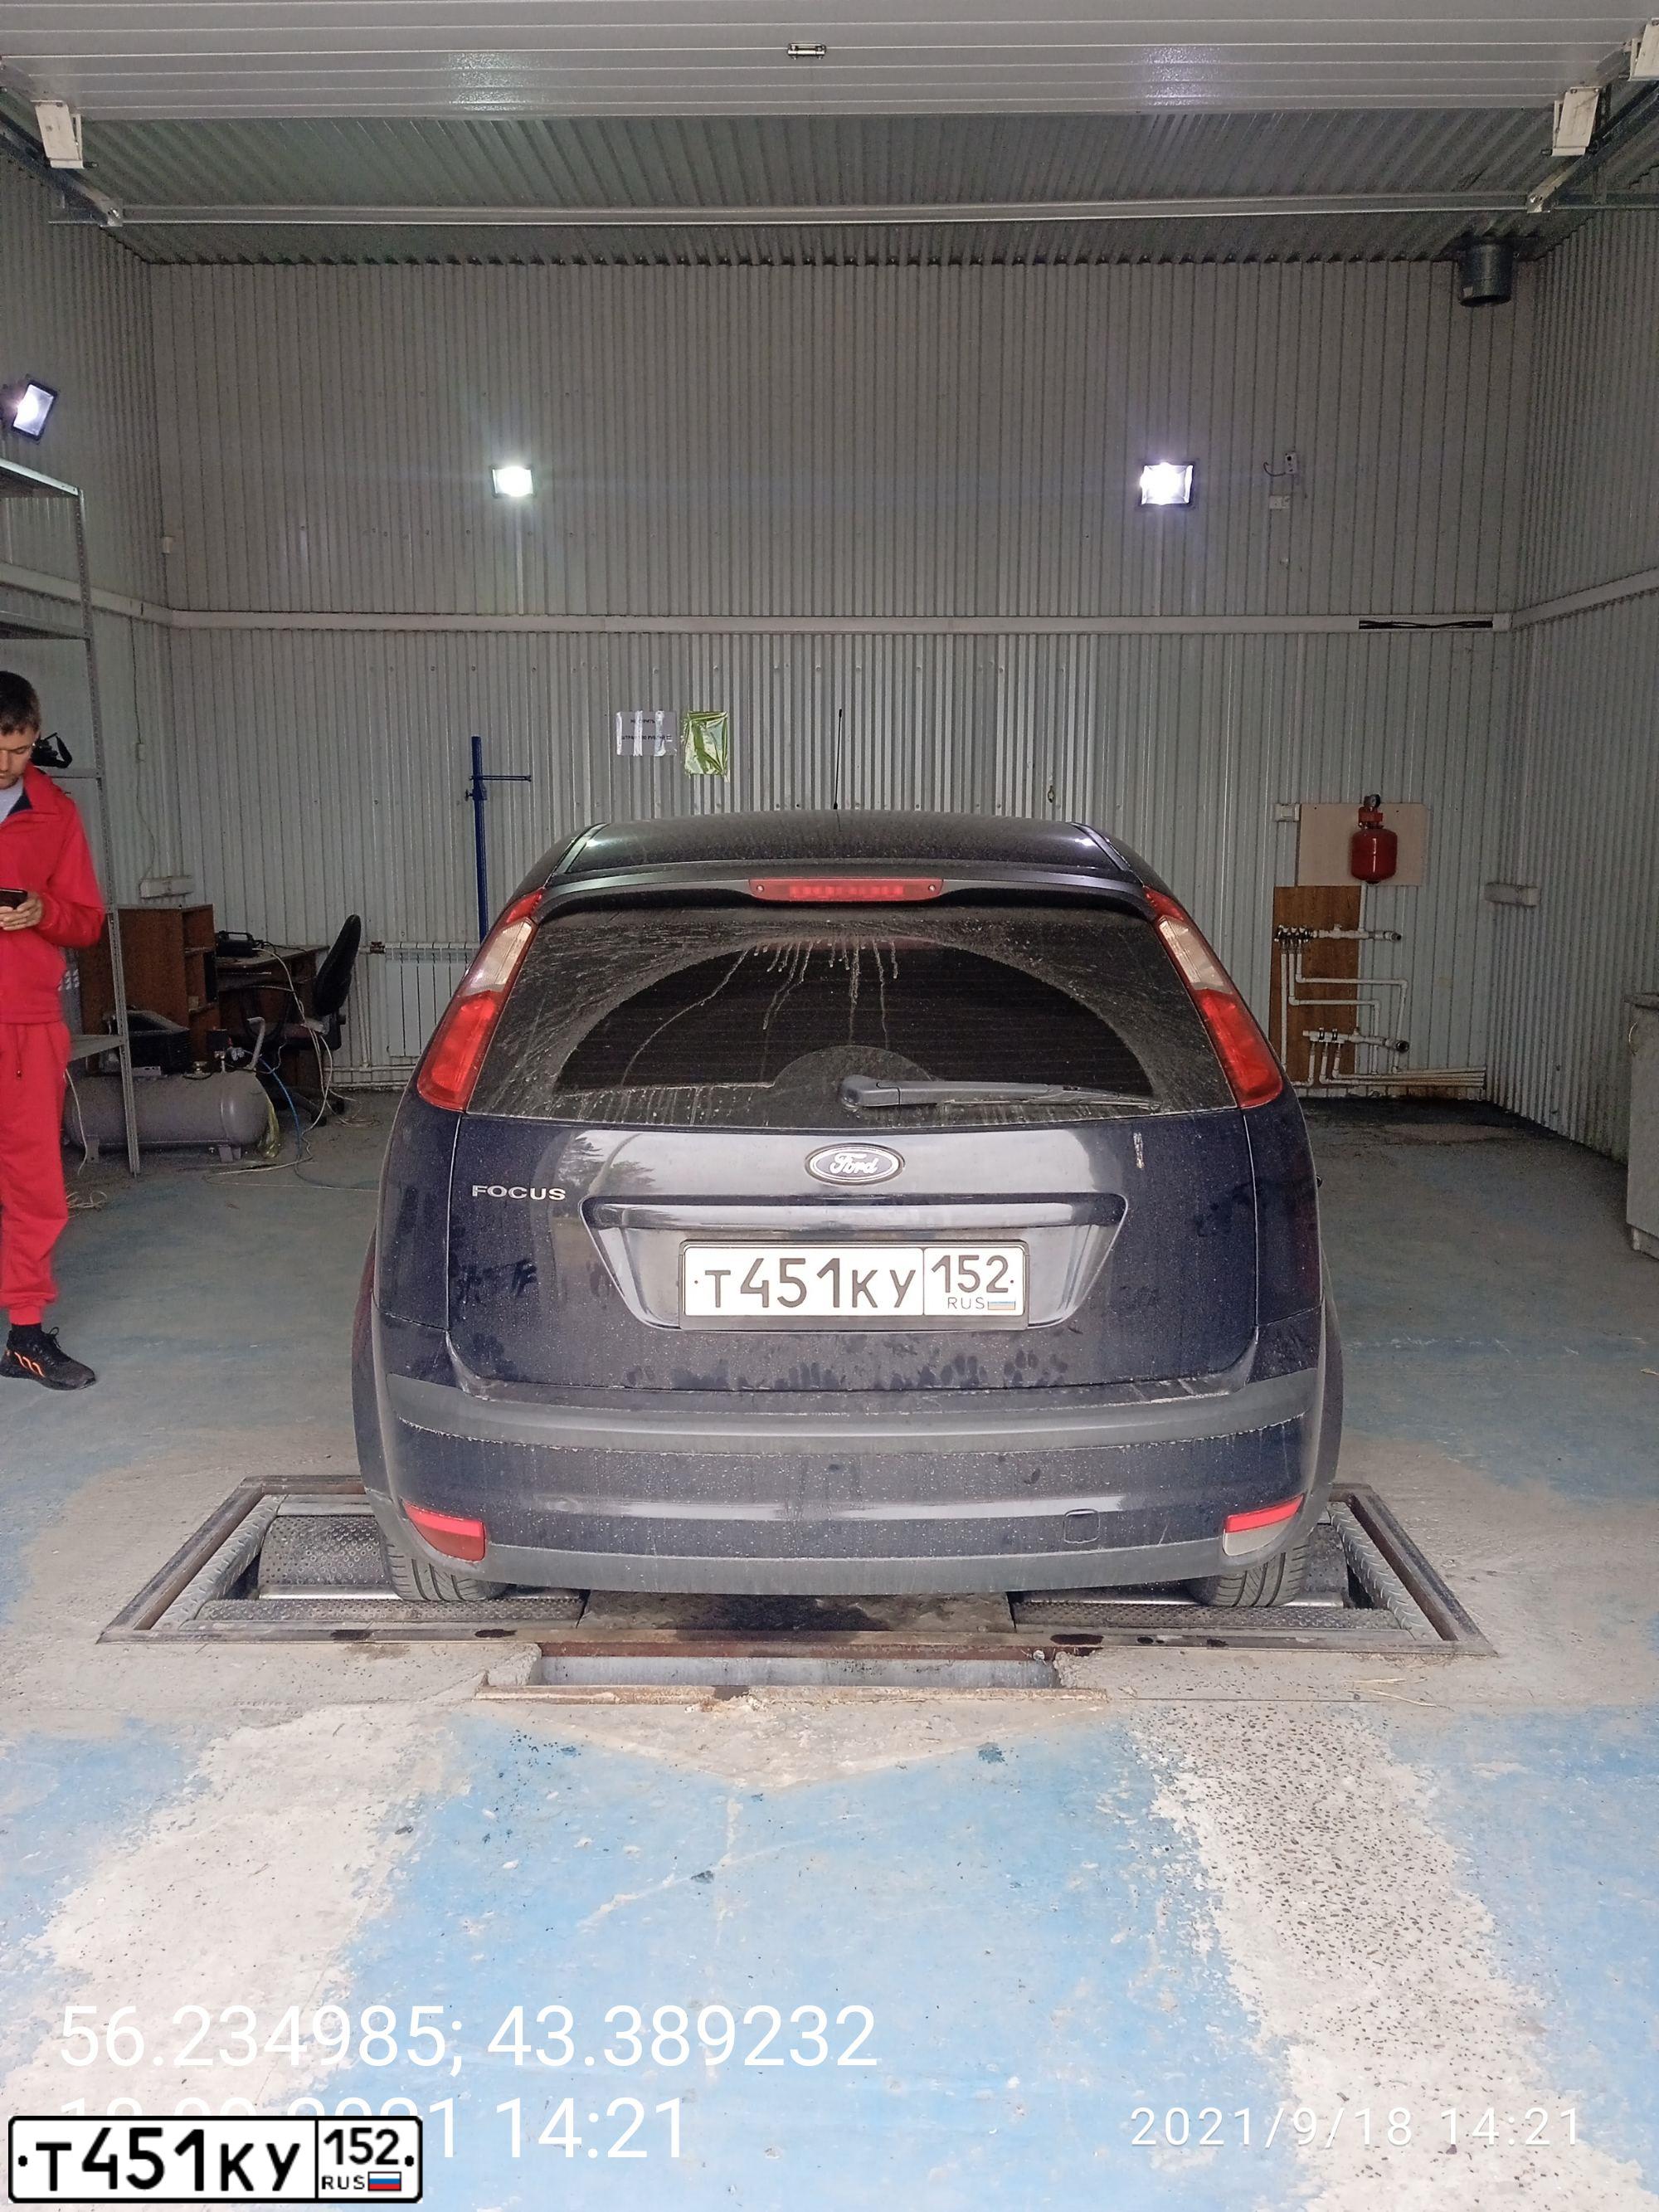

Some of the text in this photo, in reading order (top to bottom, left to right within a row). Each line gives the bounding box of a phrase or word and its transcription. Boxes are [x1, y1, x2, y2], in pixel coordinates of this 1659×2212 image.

[830, 1152, 879, 1174] Ford
[471, 1185, 566, 1201] FOCUS
[931, 1255, 1009, 1294] 152
[946, 1297, 985, 1310] RUS
